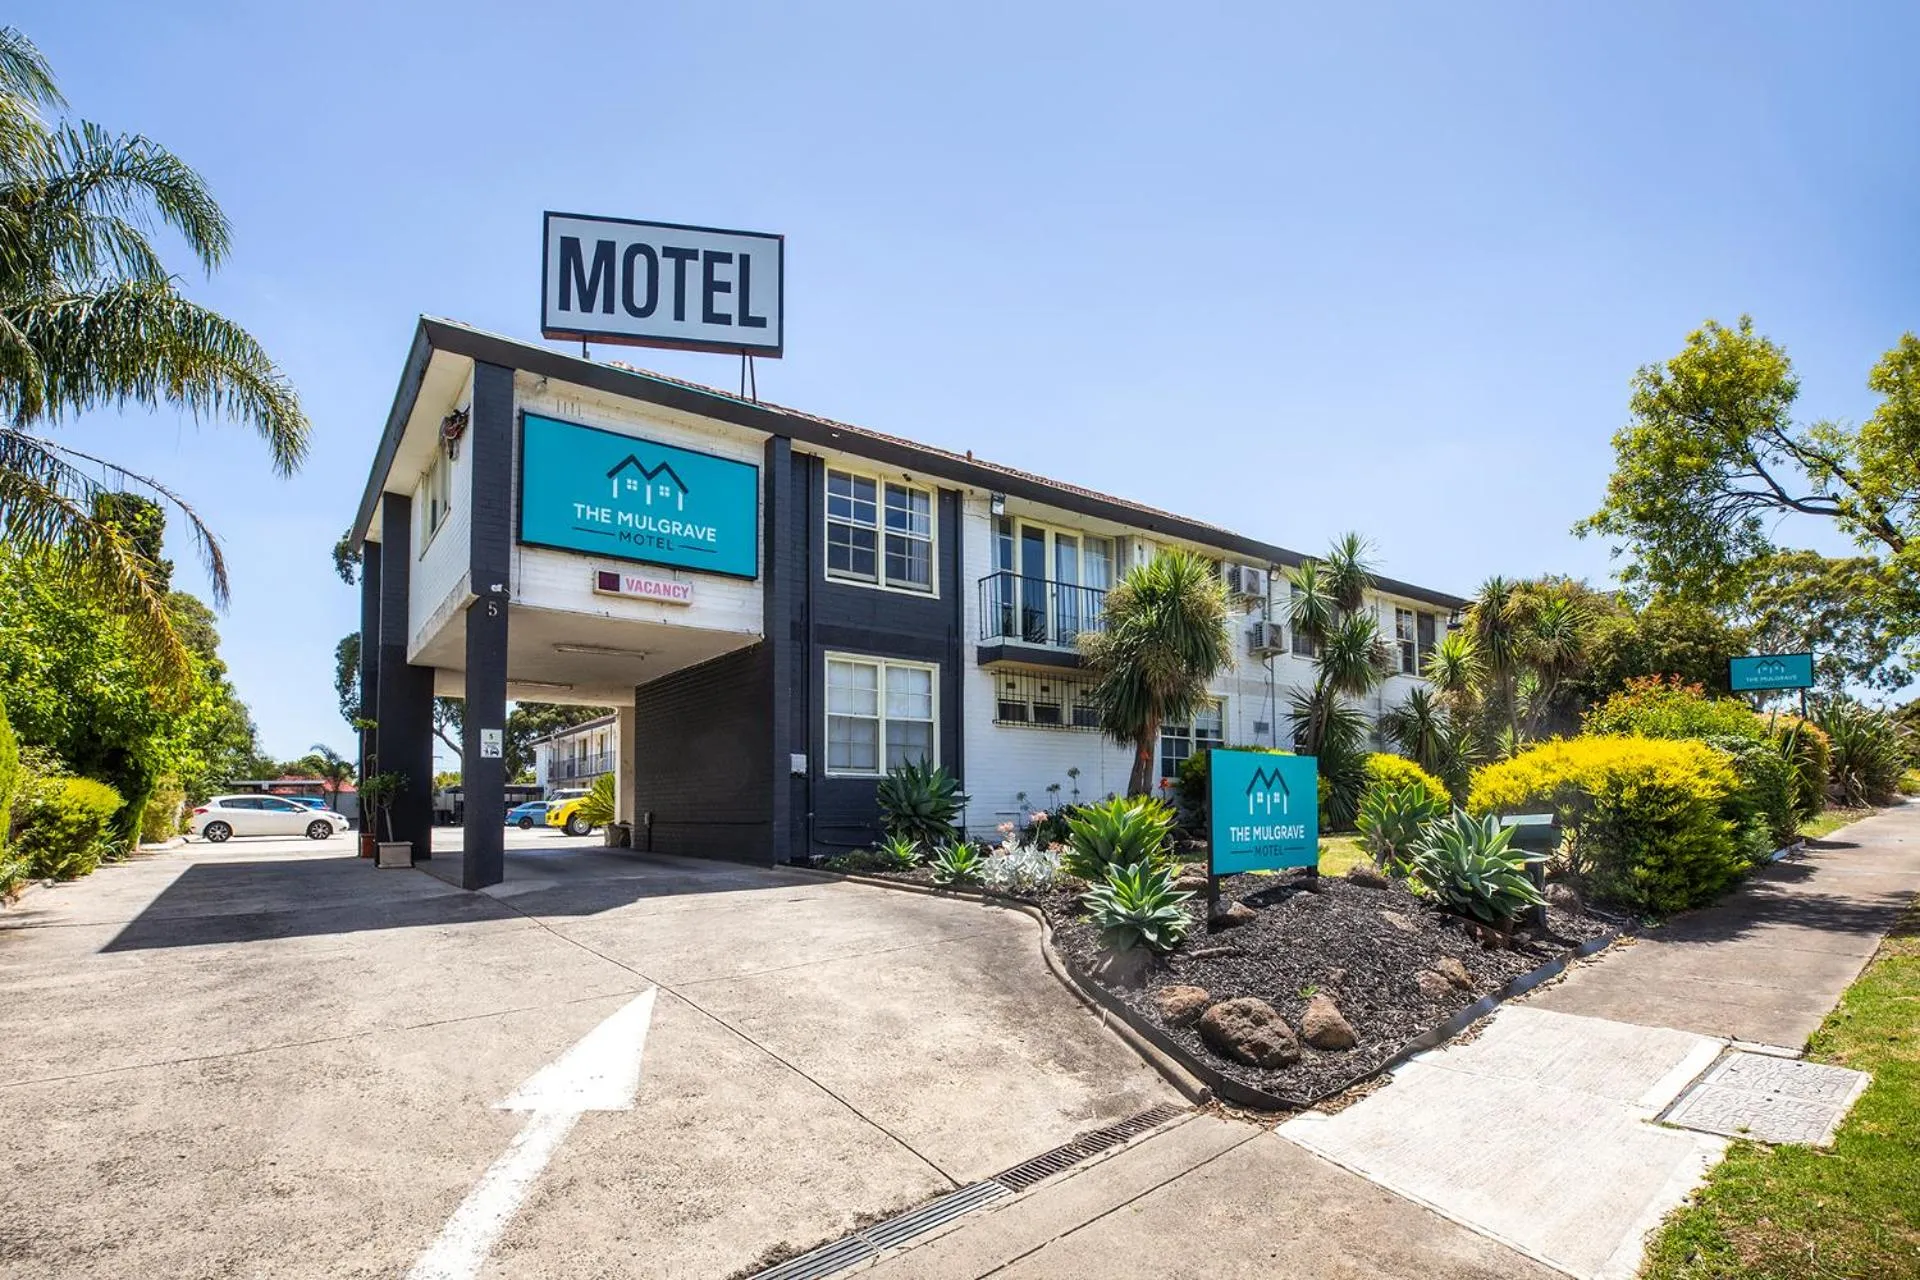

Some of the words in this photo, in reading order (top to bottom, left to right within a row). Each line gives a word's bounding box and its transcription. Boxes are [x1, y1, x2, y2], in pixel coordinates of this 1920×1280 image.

[558, 235, 767, 328] MOTEL
[573, 503, 612, 524] THE
[617, 511, 717, 543] MULGRAVE
[619, 531, 675, 551] MOTEL
[625, 577, 690, 599] VACANCY
[488, 600, 498, 617] 5
[1230, 826, 1250, 842] THE
[1252, 825, 1305, 841] MULGRAVE
[1254, 846, 1285, 857] MOTEL
